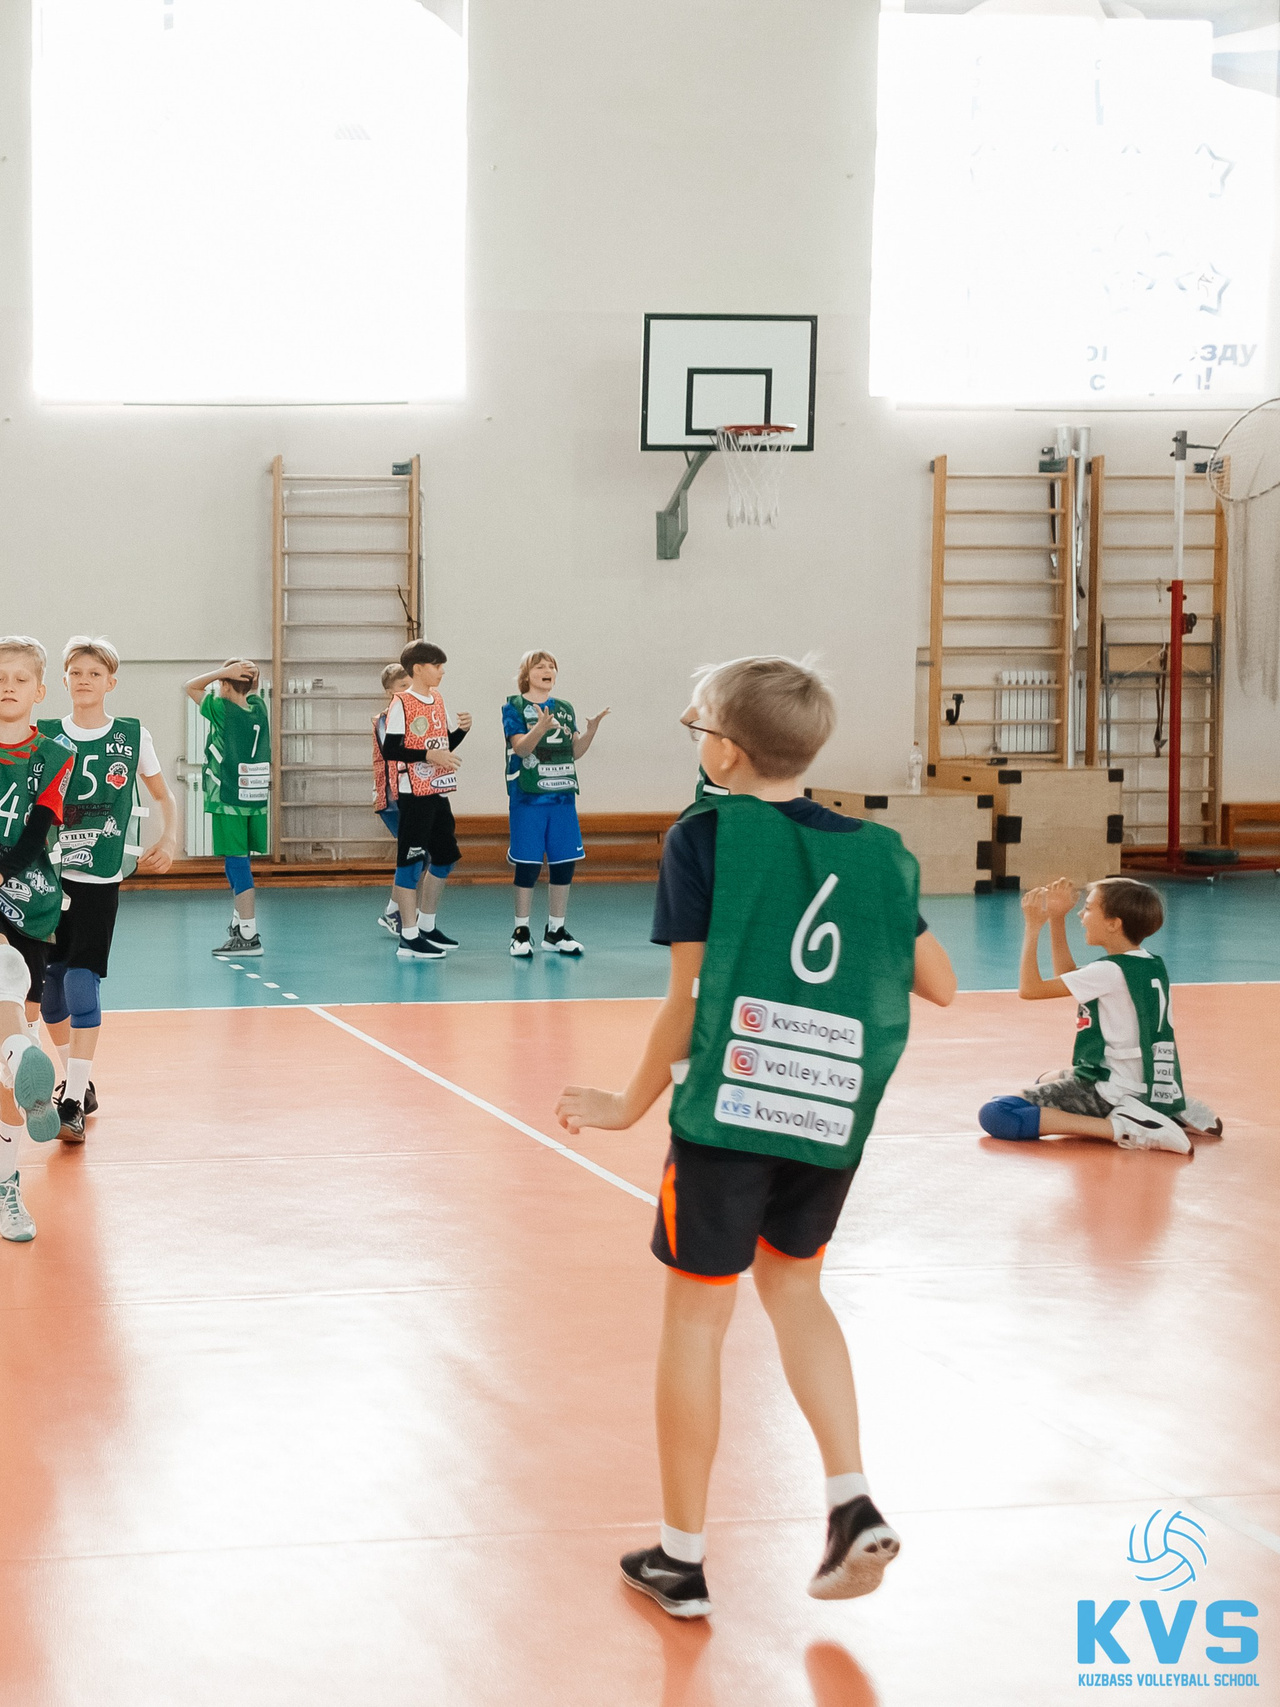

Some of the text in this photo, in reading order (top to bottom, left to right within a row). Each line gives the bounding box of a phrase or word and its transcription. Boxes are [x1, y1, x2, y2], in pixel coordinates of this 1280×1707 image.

[105, 743, 133, 756] KVS
[77, 754, 99, 801] 5
[790, 873, 840, 984] 6
[770, 1012, 856, 1046] kvsshop42
[764, 1057, 857, 1091] volley_kvs
